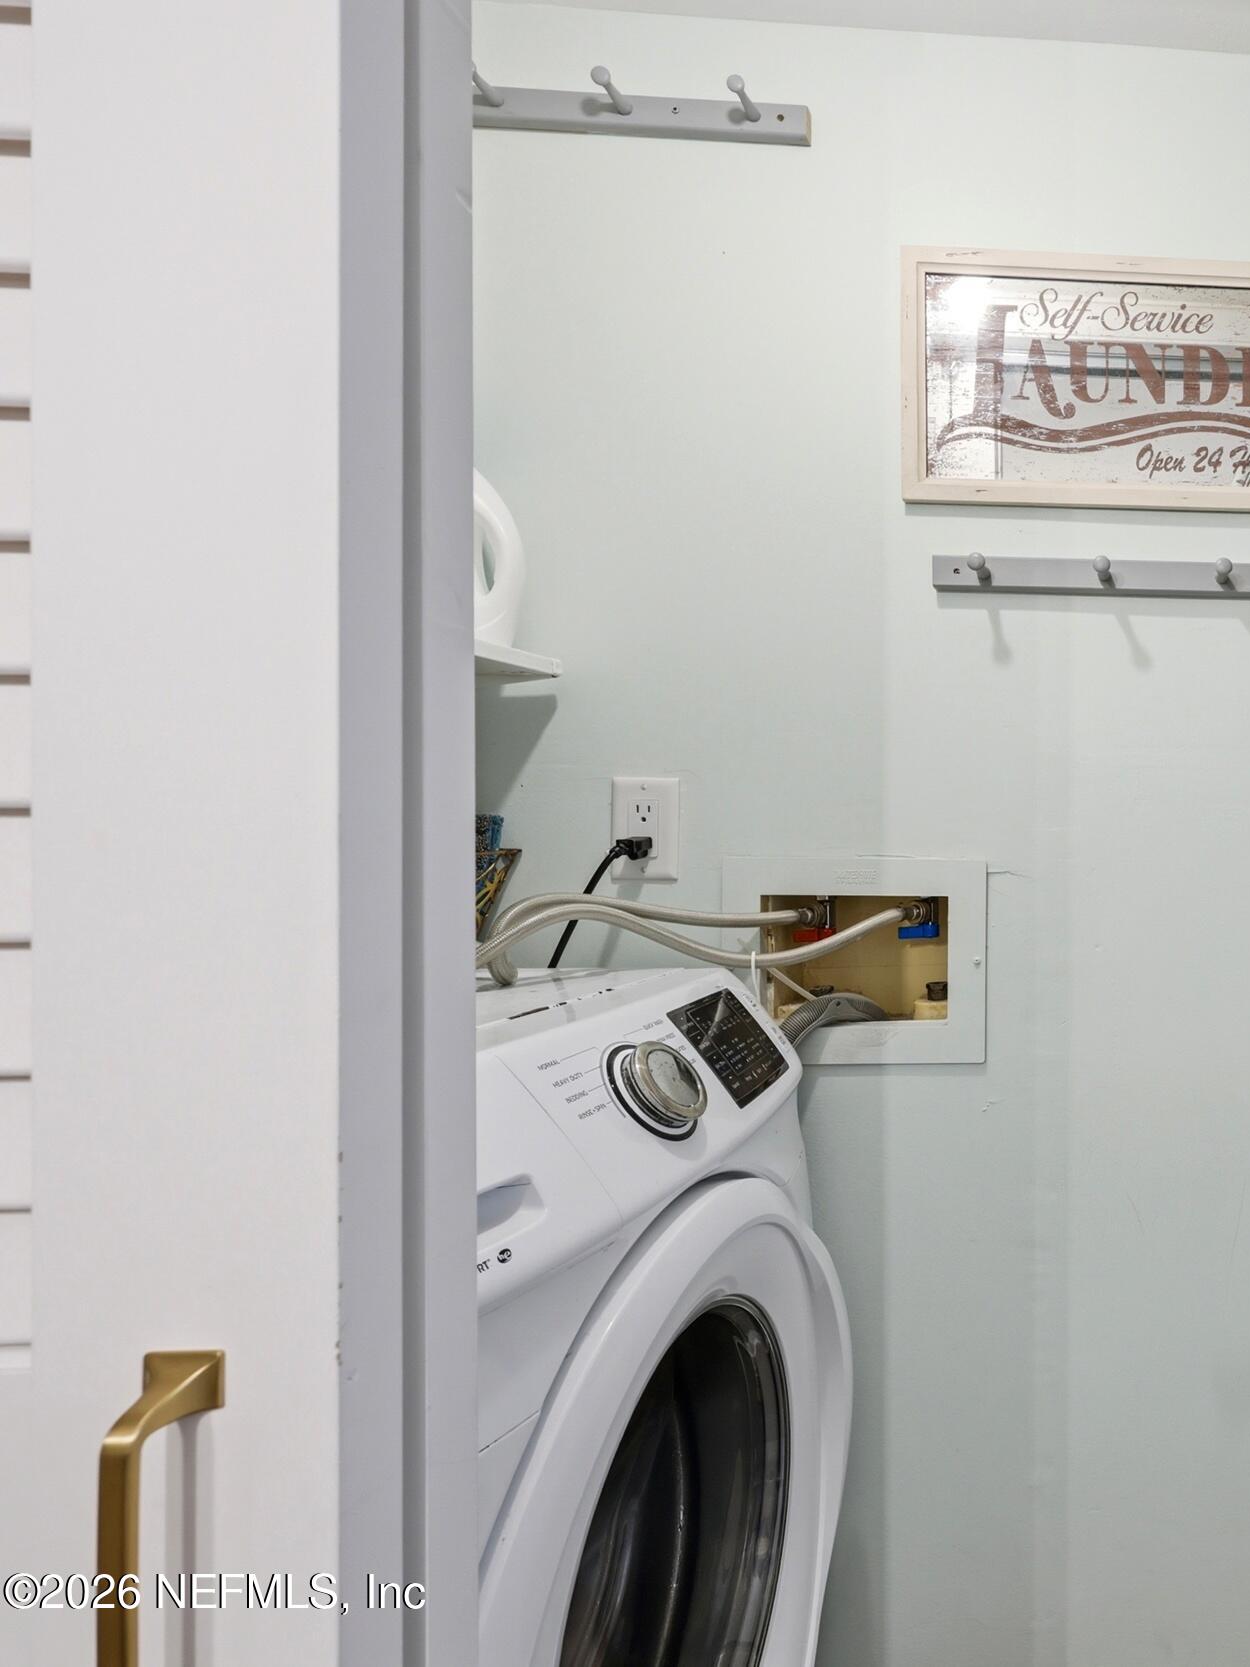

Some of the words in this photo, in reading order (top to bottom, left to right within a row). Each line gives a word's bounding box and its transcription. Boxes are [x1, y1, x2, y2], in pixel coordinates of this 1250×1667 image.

[1018, 287, 1214, 341] Self-Service
[1135, 442, 1186, 479] Open
[1193, 446, 1224, 473] 24
[536, 1058, 560, 1071] NORMAL
